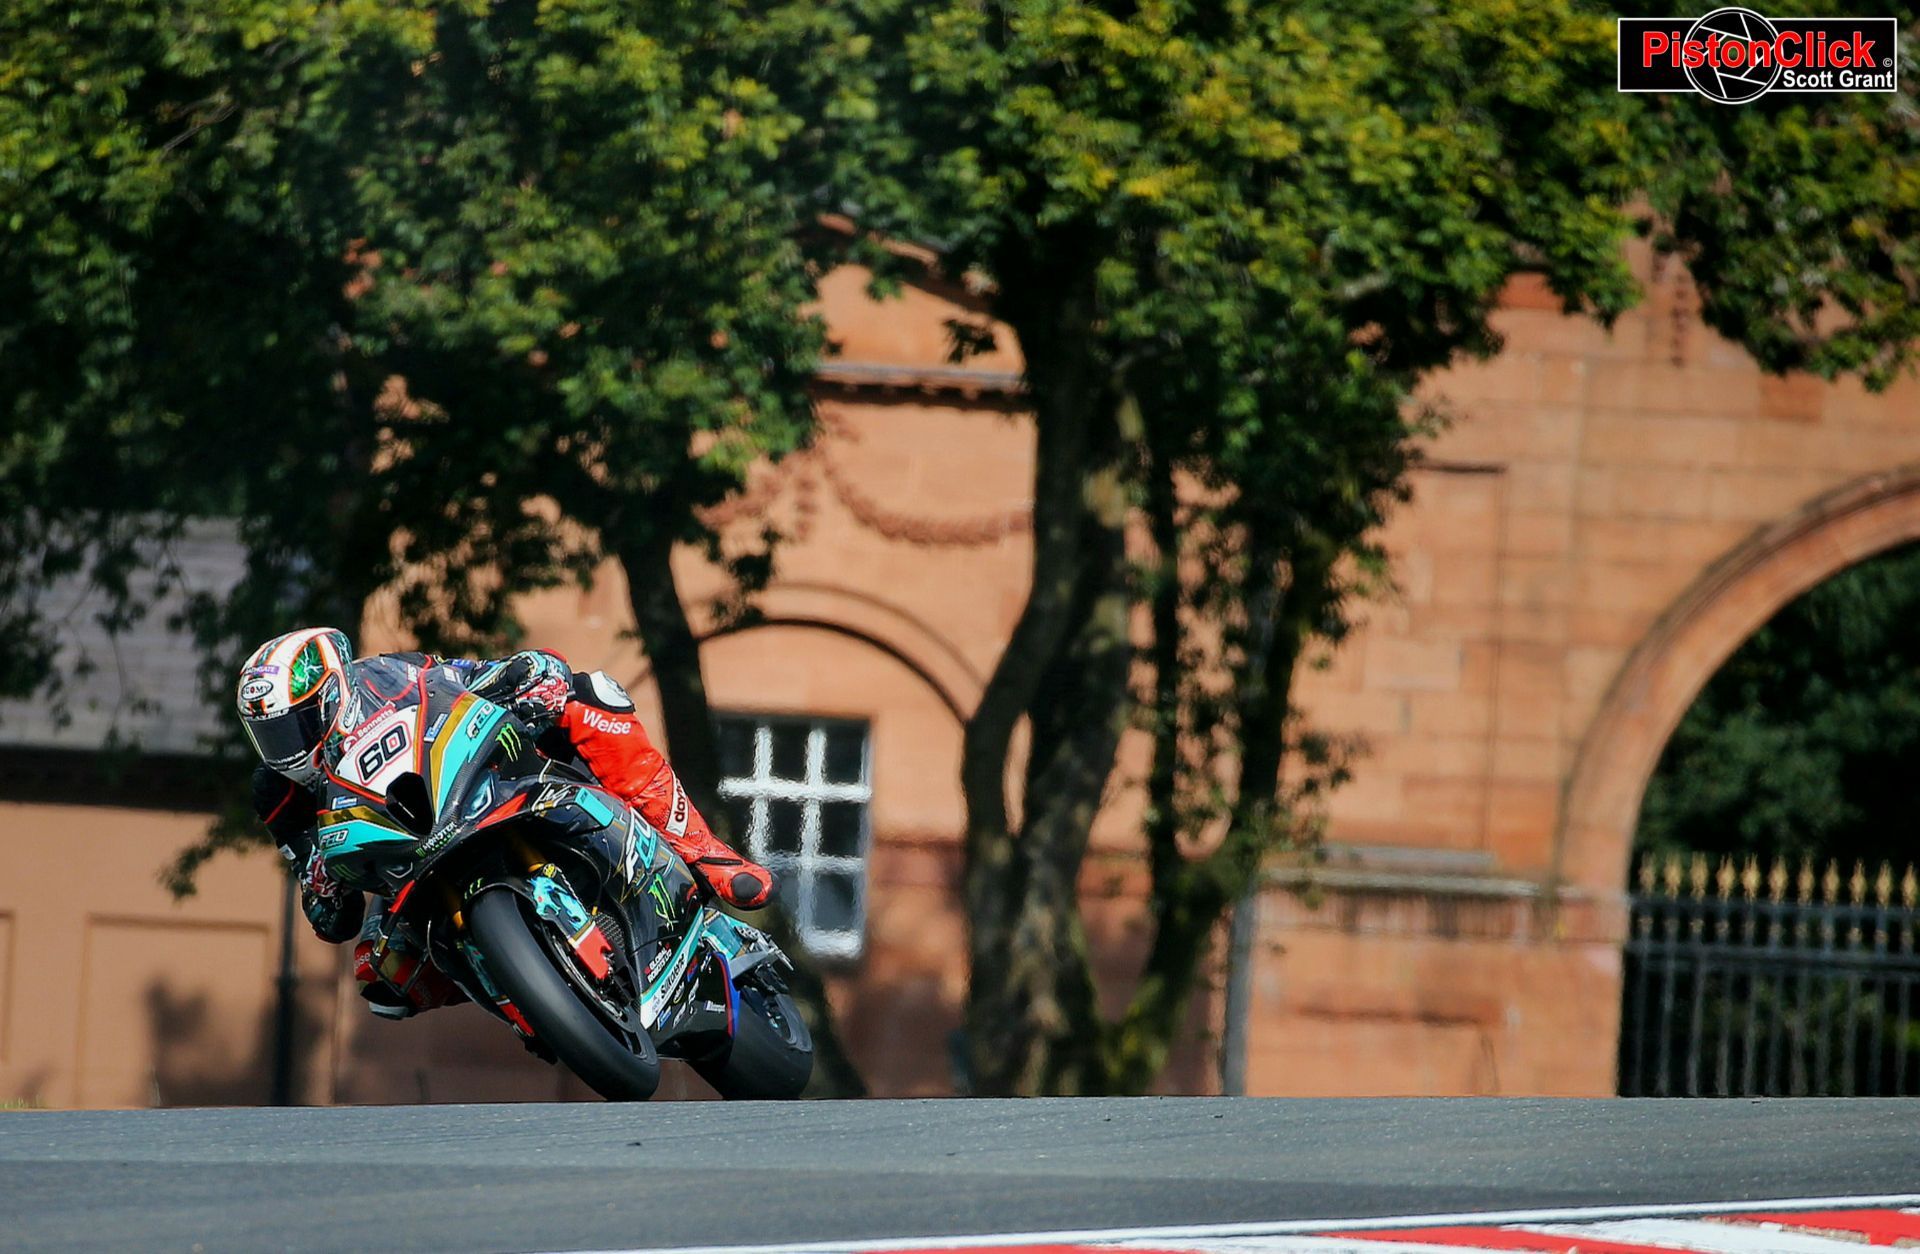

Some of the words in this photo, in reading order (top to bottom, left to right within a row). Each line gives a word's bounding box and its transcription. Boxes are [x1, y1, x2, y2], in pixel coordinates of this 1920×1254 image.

[357, 708, 394, 737] Bennetts
[583, 708, 632, 734] Weise
[358, 724, 408, 781] 60
